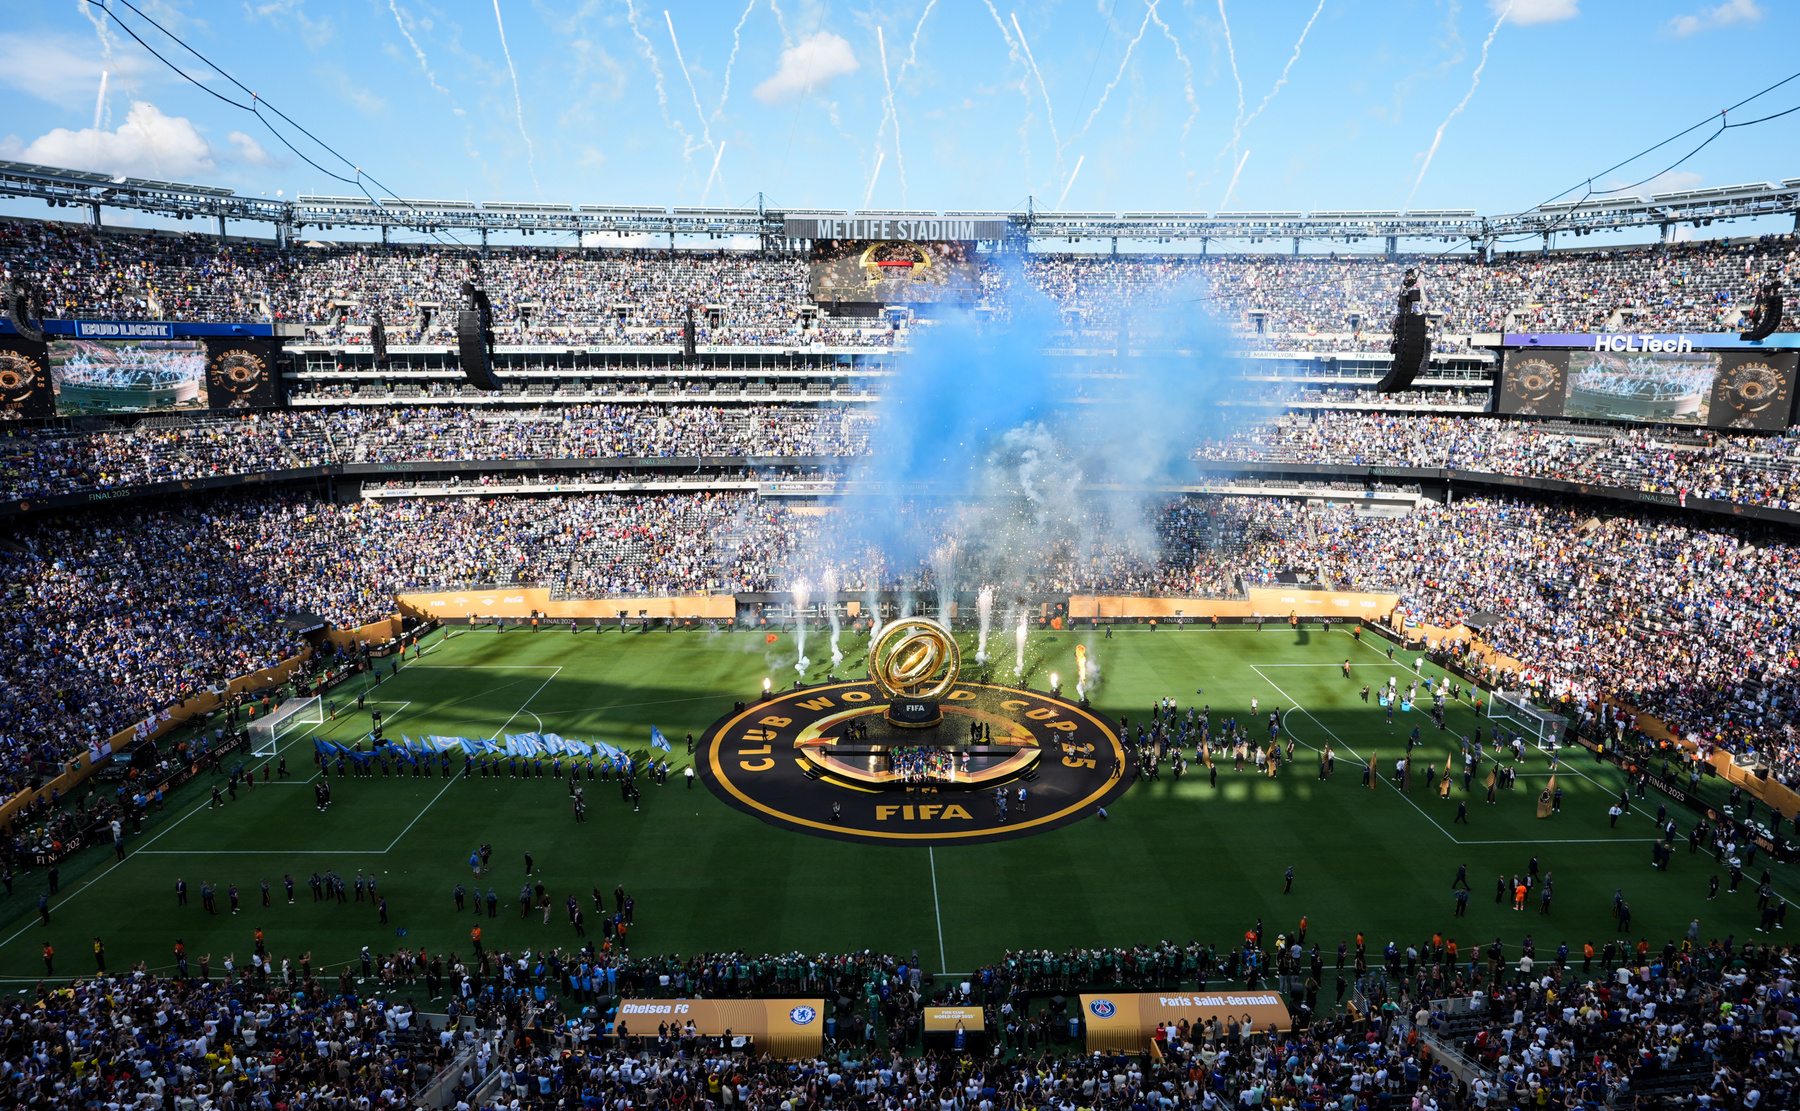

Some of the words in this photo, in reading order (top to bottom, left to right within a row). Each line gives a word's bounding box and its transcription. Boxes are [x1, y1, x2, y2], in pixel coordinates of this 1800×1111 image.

[817, 220, 891, 240] METLIFE
[897, 220, 975, 240] STADIUM
[81, 322, 120, 335] BUD
[120, 324, 168, 336] LIGHT
[1595, 335, 1692, 352] HCLTech
[210, 364, 218, 386] CLUB
[216, 349, 248, 362] WORLD
[252, 354, 266, 368] CUP
[262, 372, 268, 382] 25
[1514, 358, 1546, 370] WORLD
[1548, 364, 1561, 378] CUP
[1728, 362, 1768, 376] WORLD
[24, 356, 42, 372] CUP
[38, 376, 45, 388] 25
[1771, 368, 1786, 385] CUP
[1554, 382, 1562, 391] 25
[1718, 378, 1728, 402] CLUB
[1777, 390, 1787, 401] 25
[88, 491, 112, 501] FINAL
[112, 489, 130, 498] 2025
[1639, 494, 1658, 502] FINAL
[1660, 496, 1677, 504] 2025
[738, 716, 792, 771] CLUB
[795, 688, 976, 711] WOD
[1000, 700, 1078, 731] CUP
[1648, 776, 1668, 792] FINAL
[1668, 786, 1685, 801] 2025
[876, 804, 974, 820] FIFA
[1160, 997, 1192, 1006] Paris
[1193, 995, 1278, 1006] Saint-Germain
[622, 1004, 671, 1014] Chelsea
[674, 1004, 689, 1014] FC
